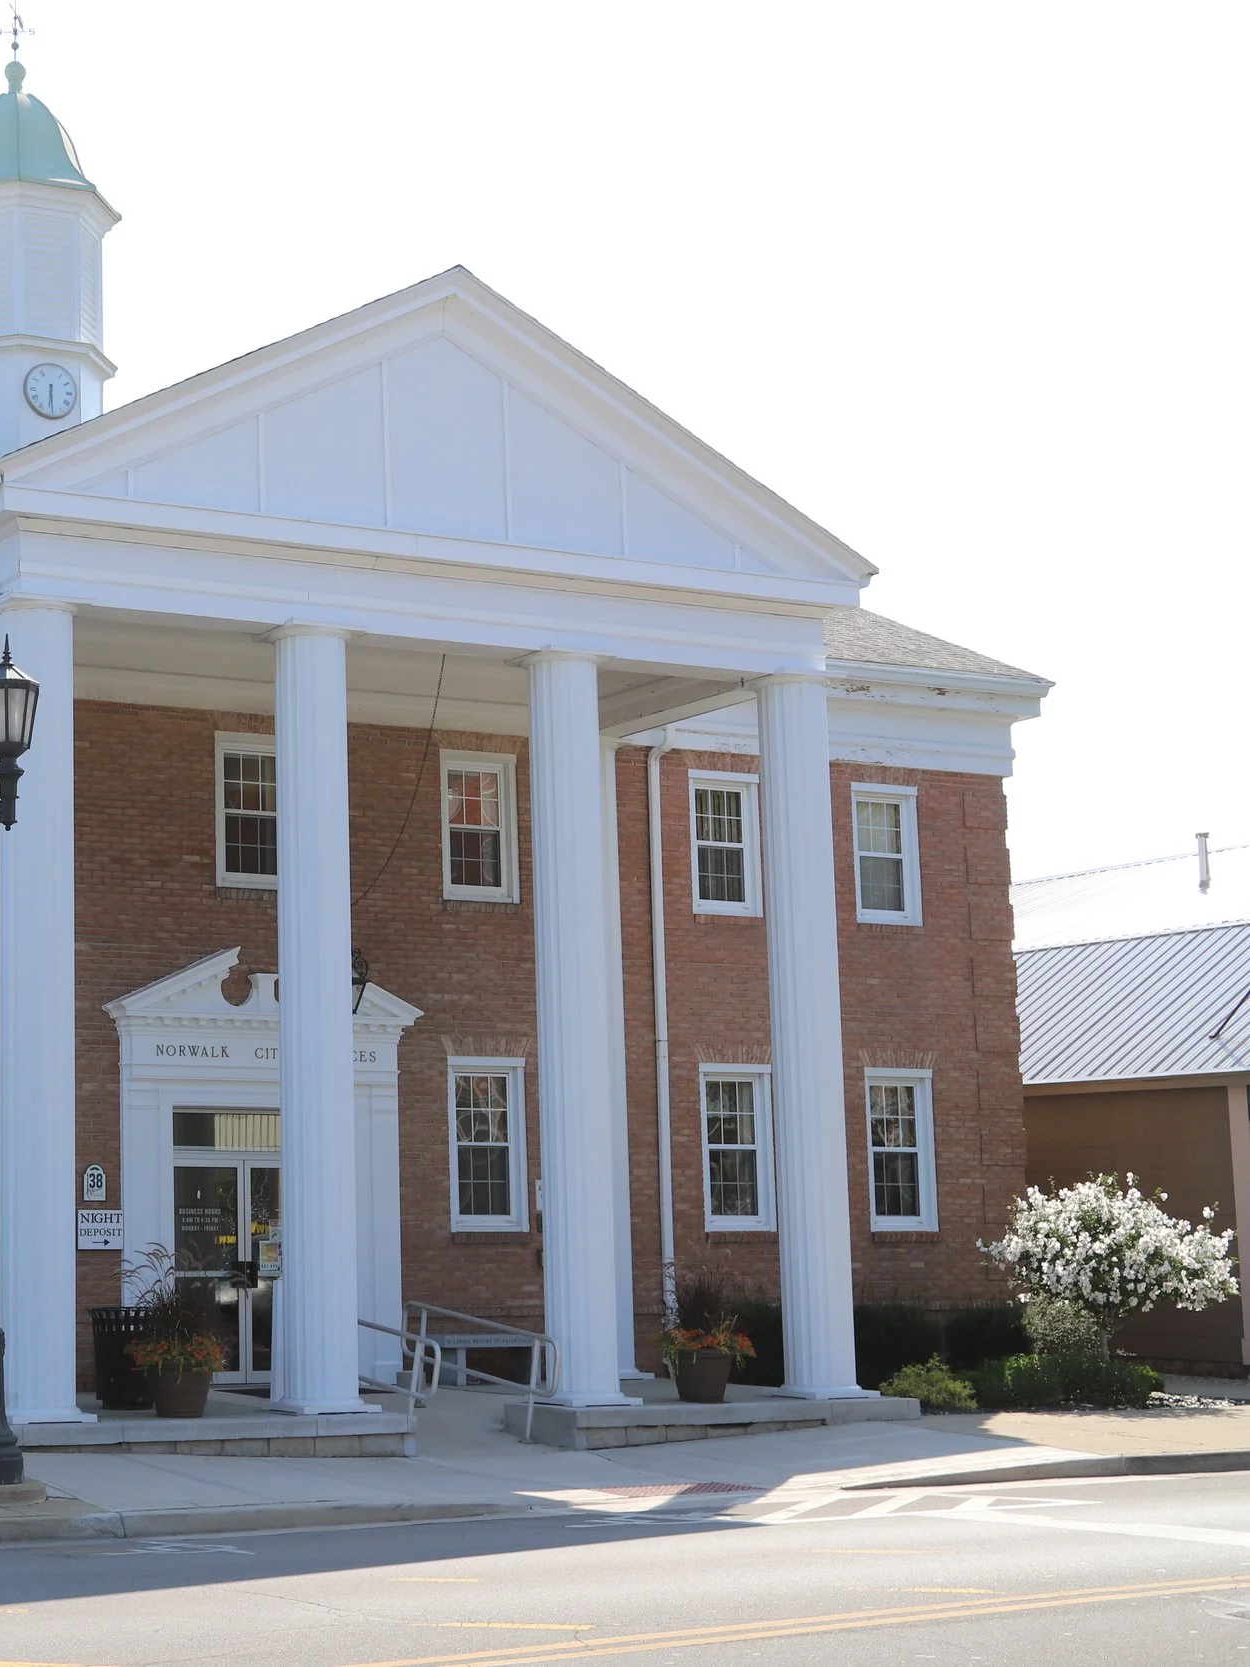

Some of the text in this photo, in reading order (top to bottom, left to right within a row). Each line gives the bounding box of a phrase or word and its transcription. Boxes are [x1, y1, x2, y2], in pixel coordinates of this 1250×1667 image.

[155, 1044, 230, 1058] NORWALK
[254, 1047, 279, 1060] CIT
[89, 1173, 103, 1189] 38
[80, 1213, 122, 1223] NIGHT
[79, 1228, 122, 1236] DEPOSIT
